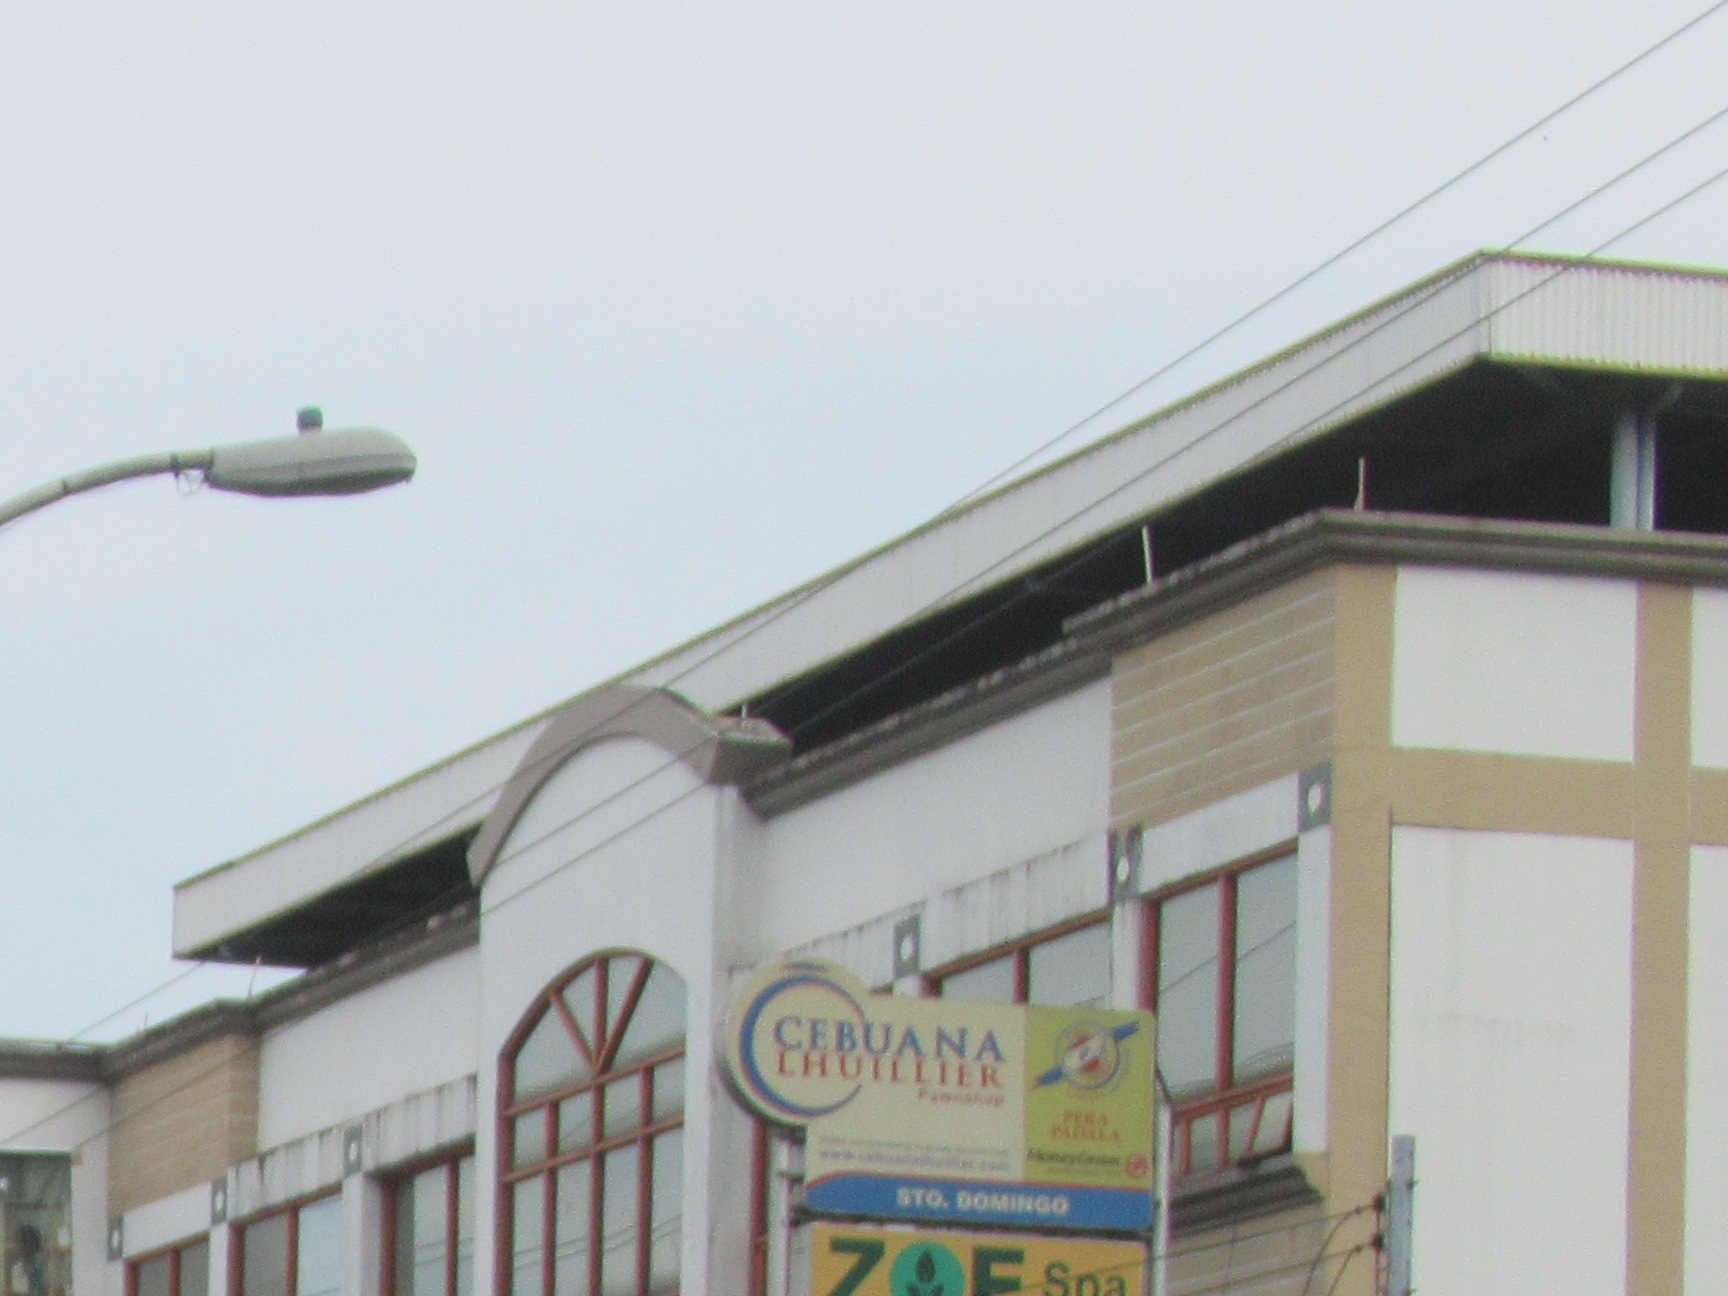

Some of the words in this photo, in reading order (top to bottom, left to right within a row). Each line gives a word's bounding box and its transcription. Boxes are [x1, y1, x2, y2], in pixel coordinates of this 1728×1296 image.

[773, 1014, 1006, 1063] CEBUANA
[776, 1049, 1002, 1089] LHUILLIER
[957, 1190, 1070, 1215] DOMINGO
